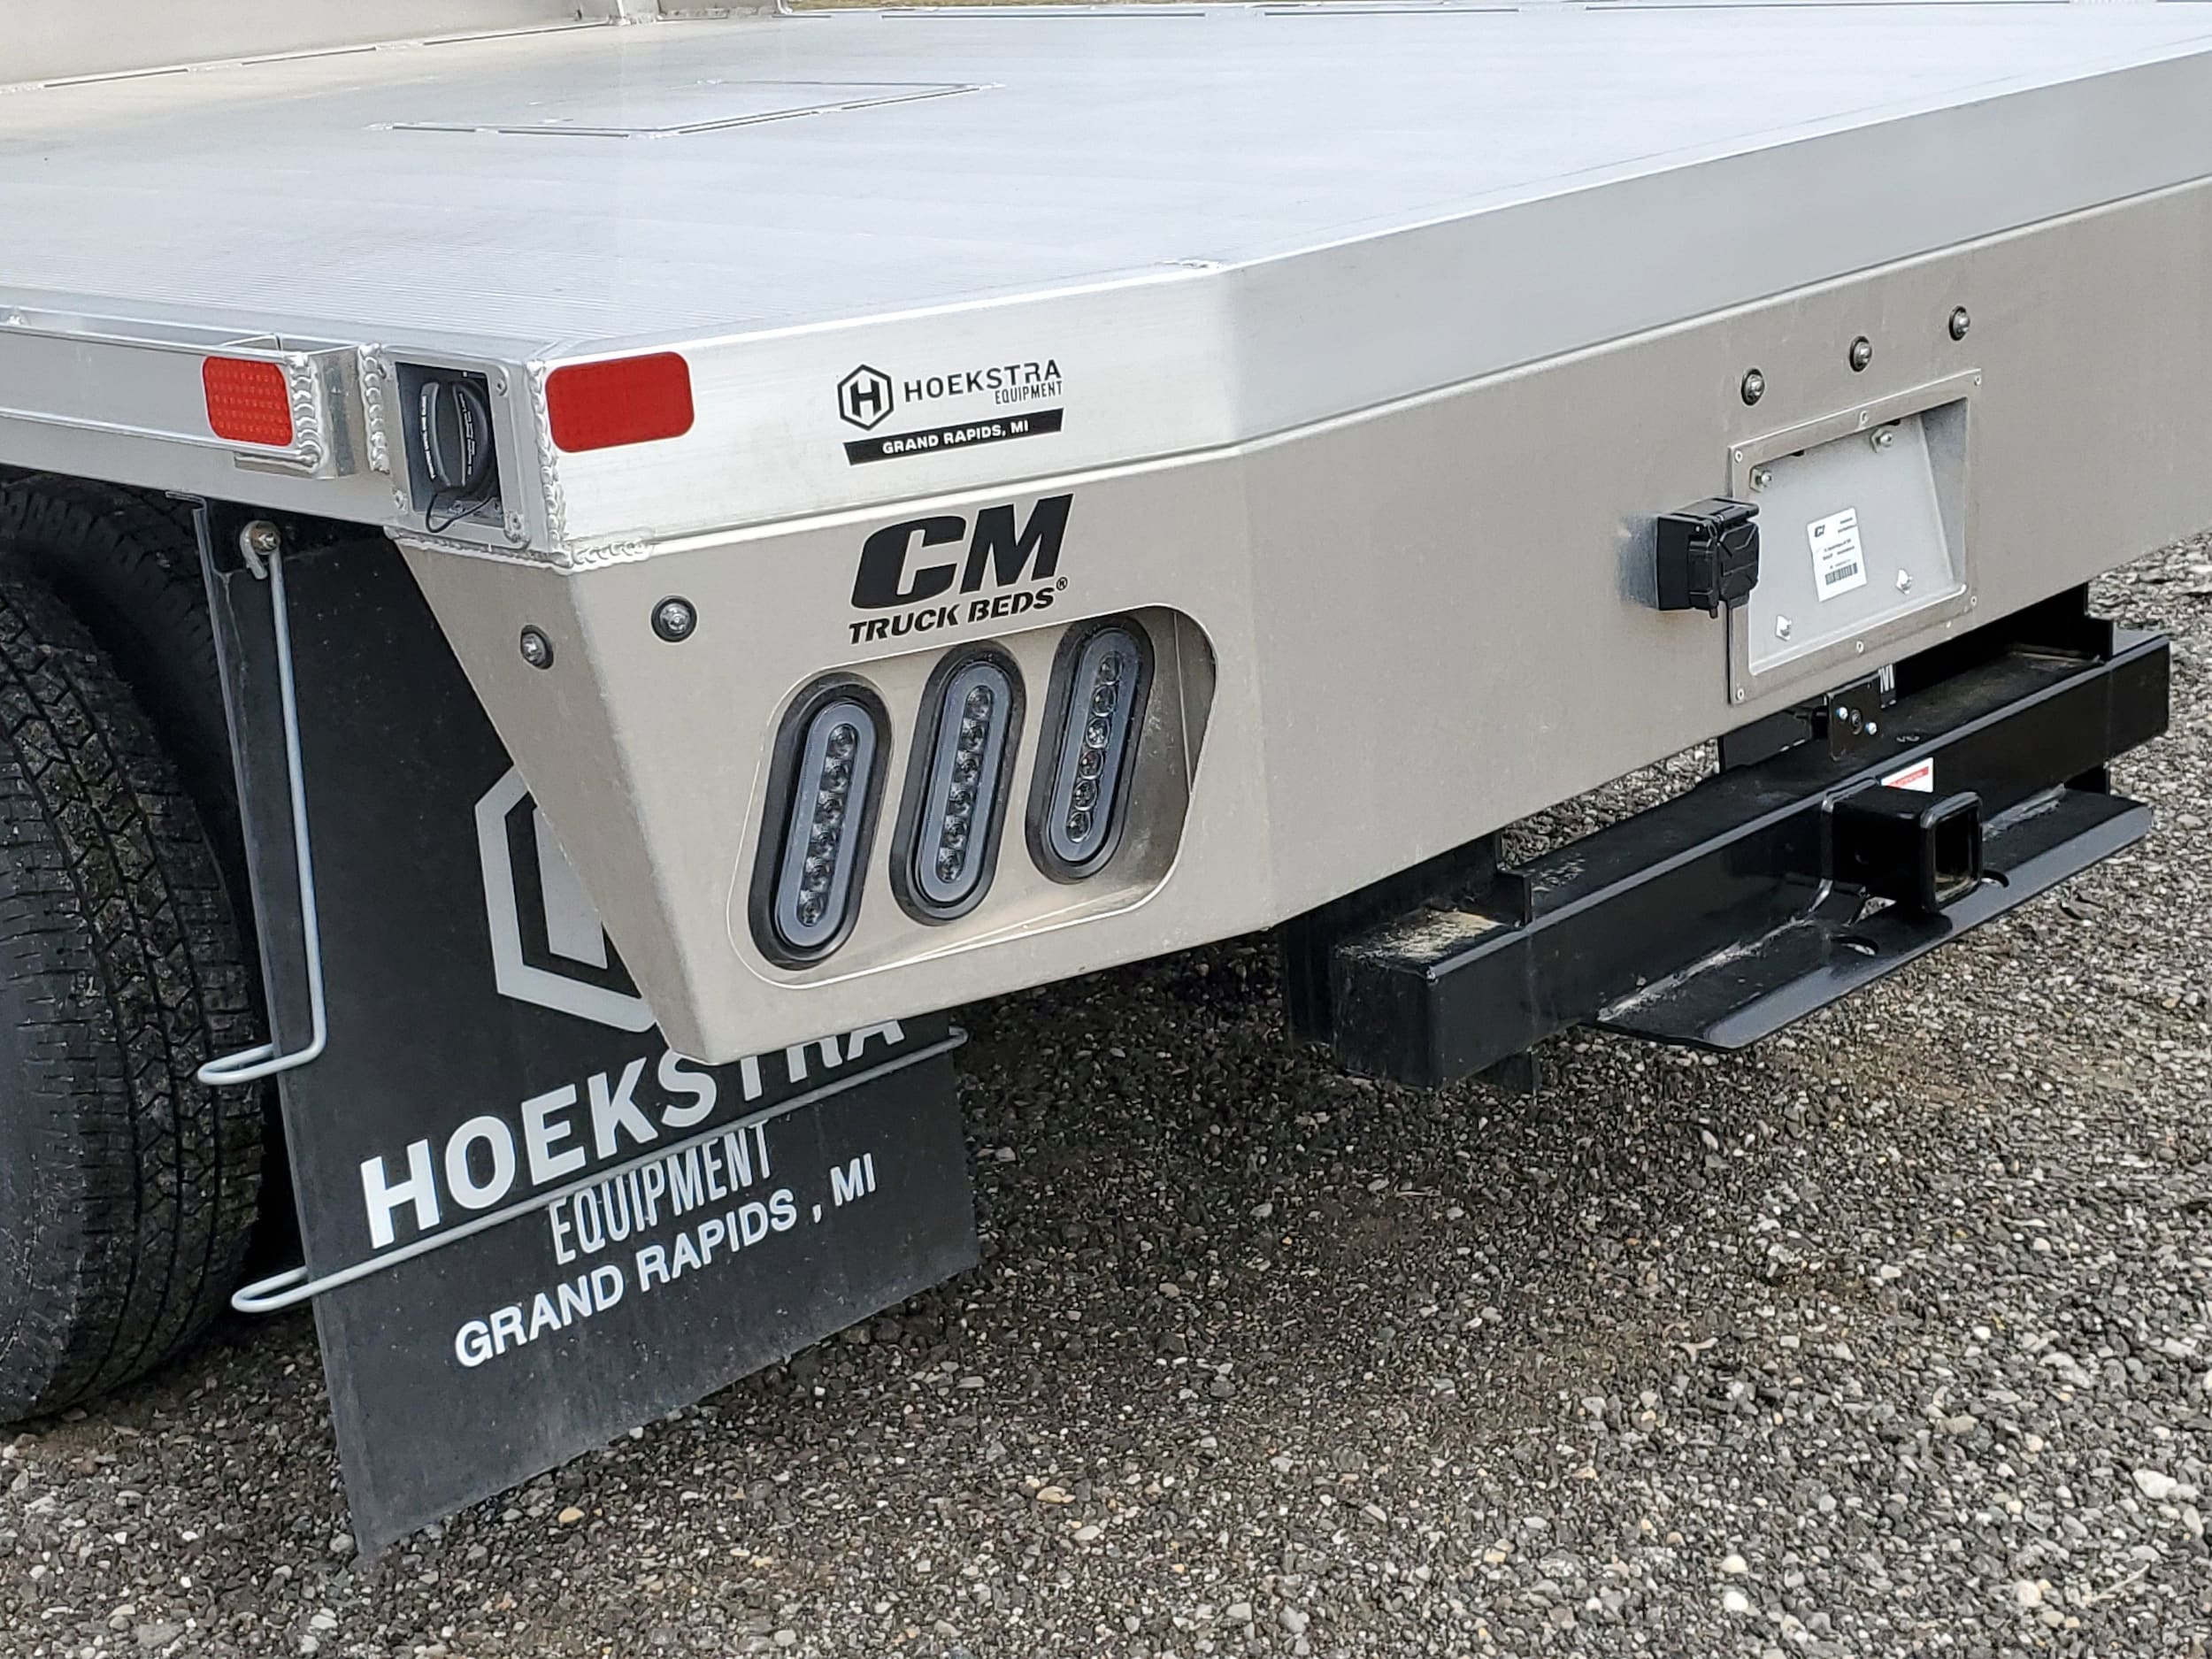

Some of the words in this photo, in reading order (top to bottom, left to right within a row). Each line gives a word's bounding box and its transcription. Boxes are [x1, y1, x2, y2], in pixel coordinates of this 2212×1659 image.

[903, 359, 1062, 403] HOEKSTRA
[995, 380, 1062, 404] EQUIPMENT
[882, 434, 939, 454] GRAND
[943, 424, 1007, 444] RAPIDS,
[1010, 419, 1029, 434] MI
[850, 493, 1074, 610] CM
[849, 603, 962, 645] TRUCK
[548, 1118, 772, 1265] EQUIPMENT
[455, 1264, 624, 1368] GRAND
[635, 1188, 797, 1293] RAPIDS
[830, 1152, 877, 1207] MI
